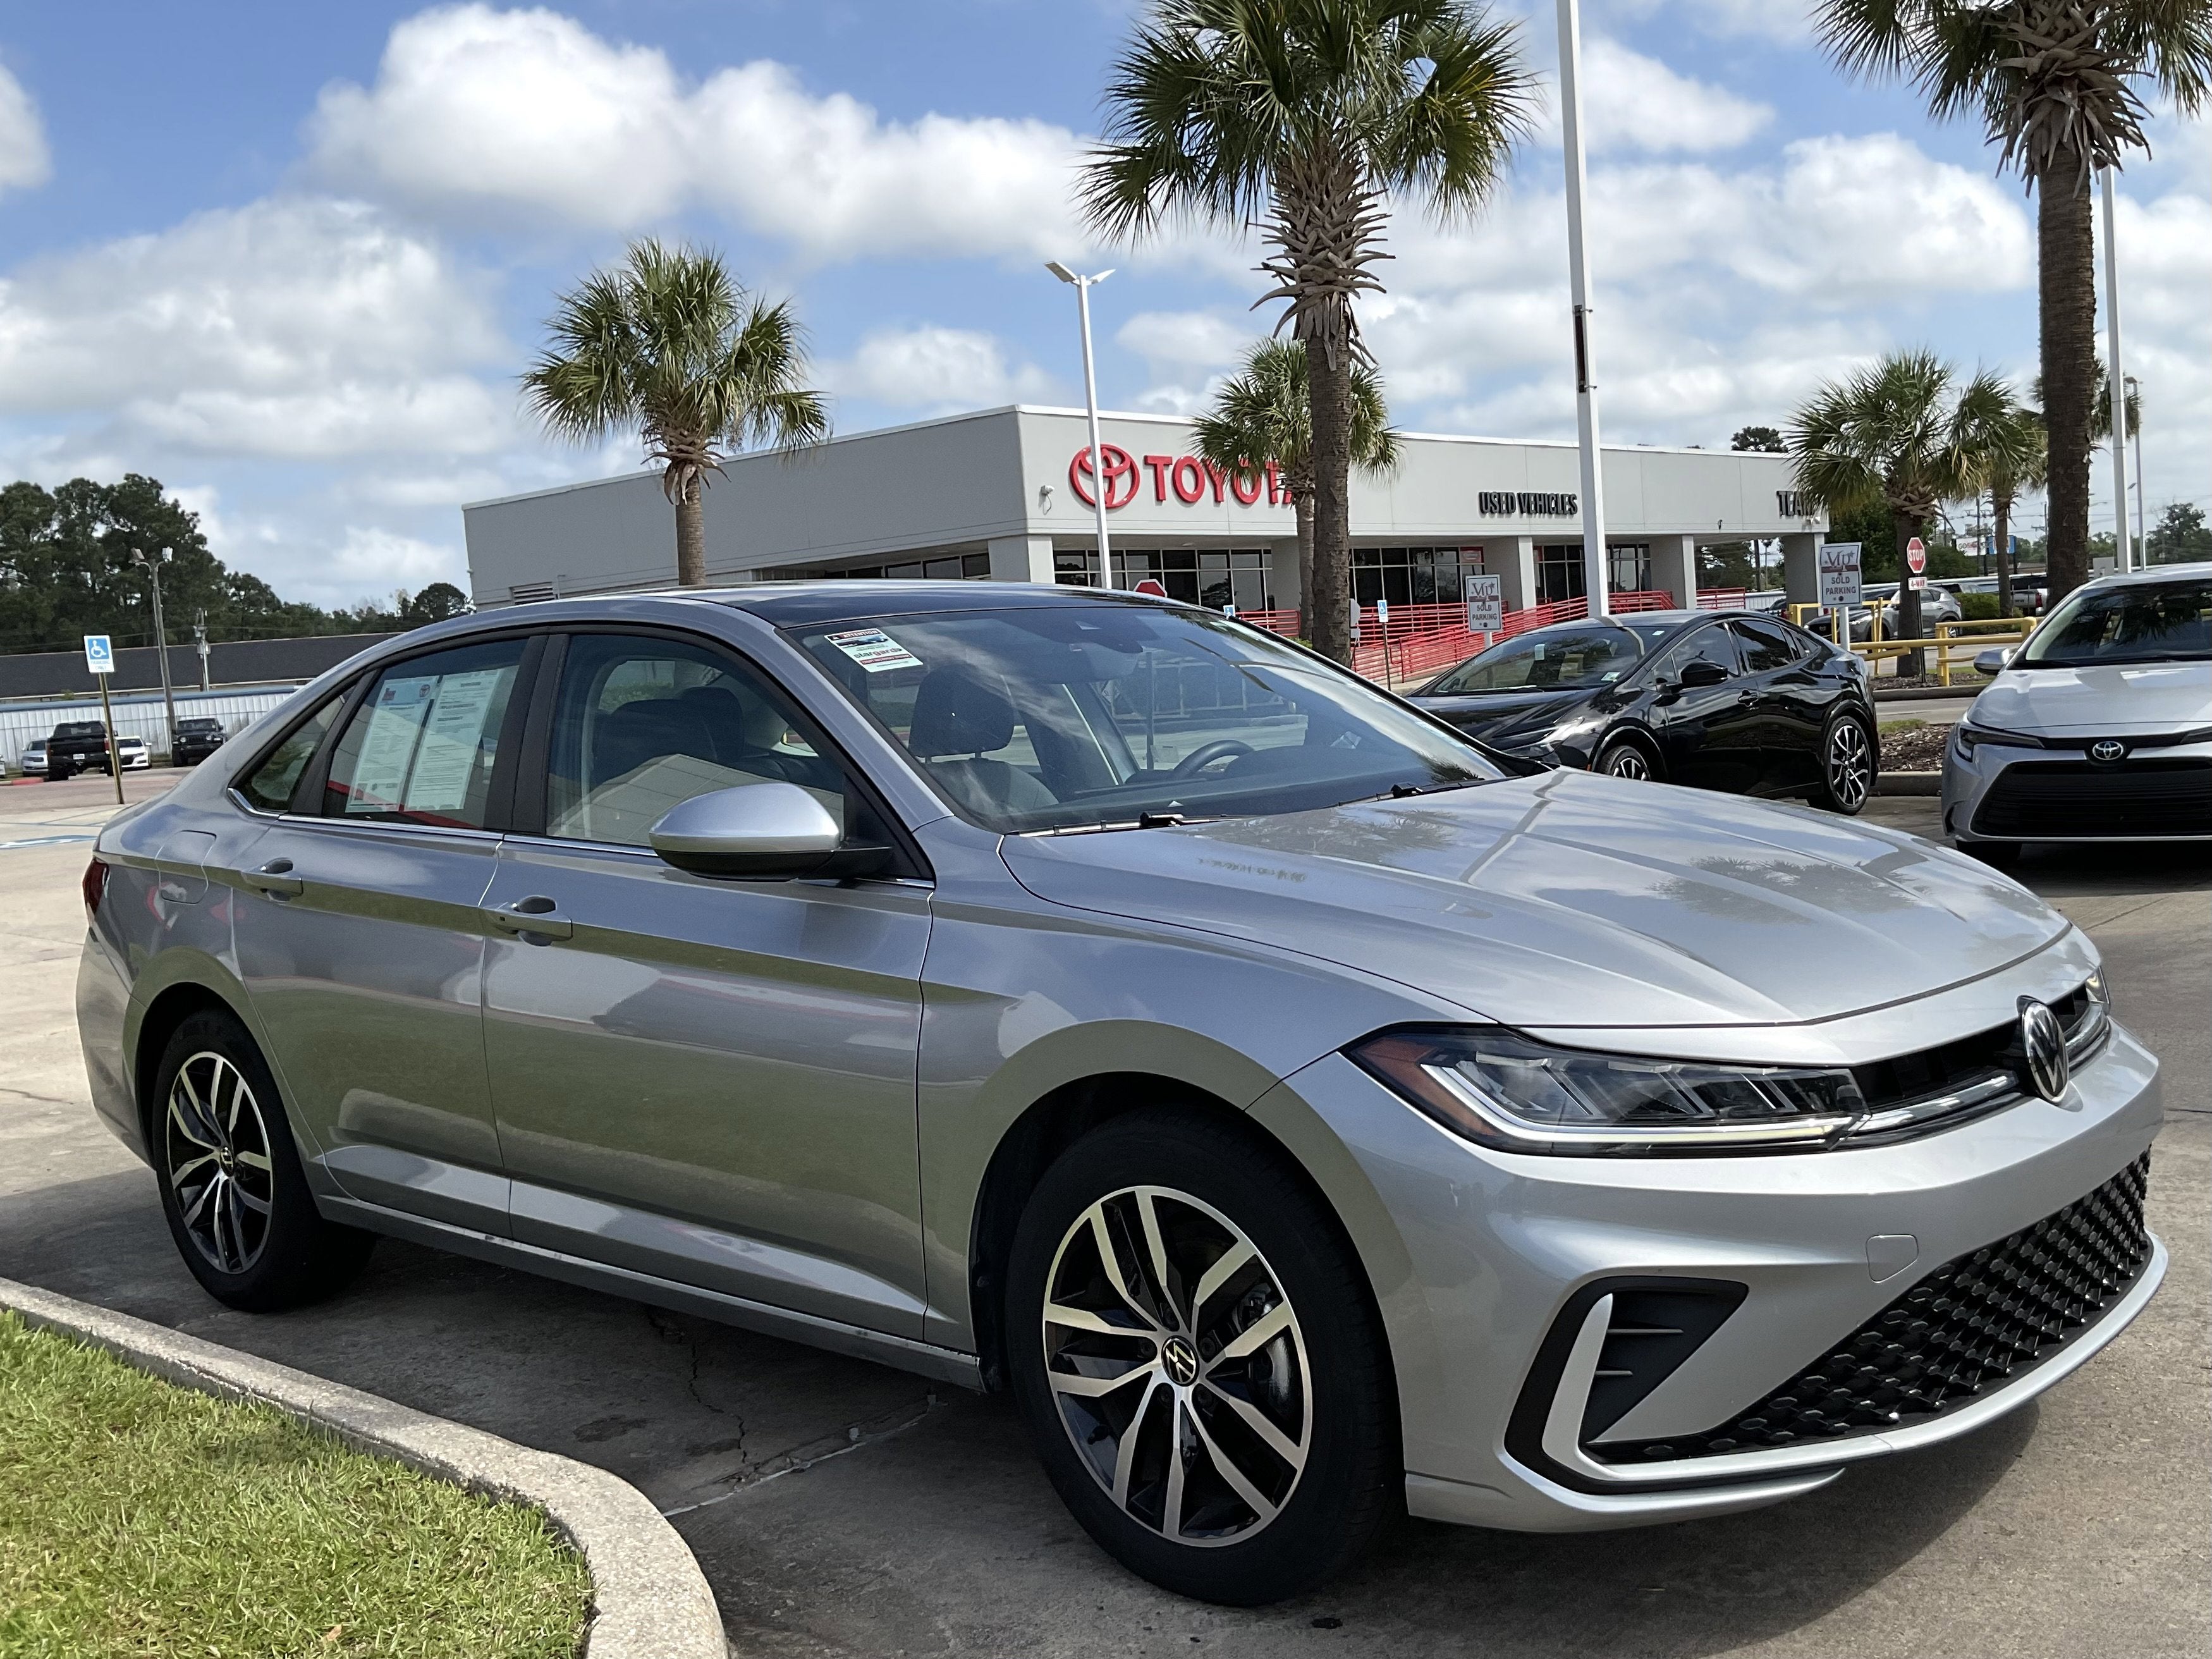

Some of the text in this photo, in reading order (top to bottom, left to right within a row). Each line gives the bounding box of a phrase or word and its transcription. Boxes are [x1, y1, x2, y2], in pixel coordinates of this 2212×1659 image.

[1144, 455, 1292, 505] TOYOT
[1478, 492, 1578, 515] USED VEHICLES
[1909, 549, 1924, 561] STOP
[1831, 576, 1850, 585] SOLD
[1910, 579, 1925, 588] 4-WAY
[1825, 586, 1857, 595] PARKING
[843, 630, 880, 639] ATTENTION
